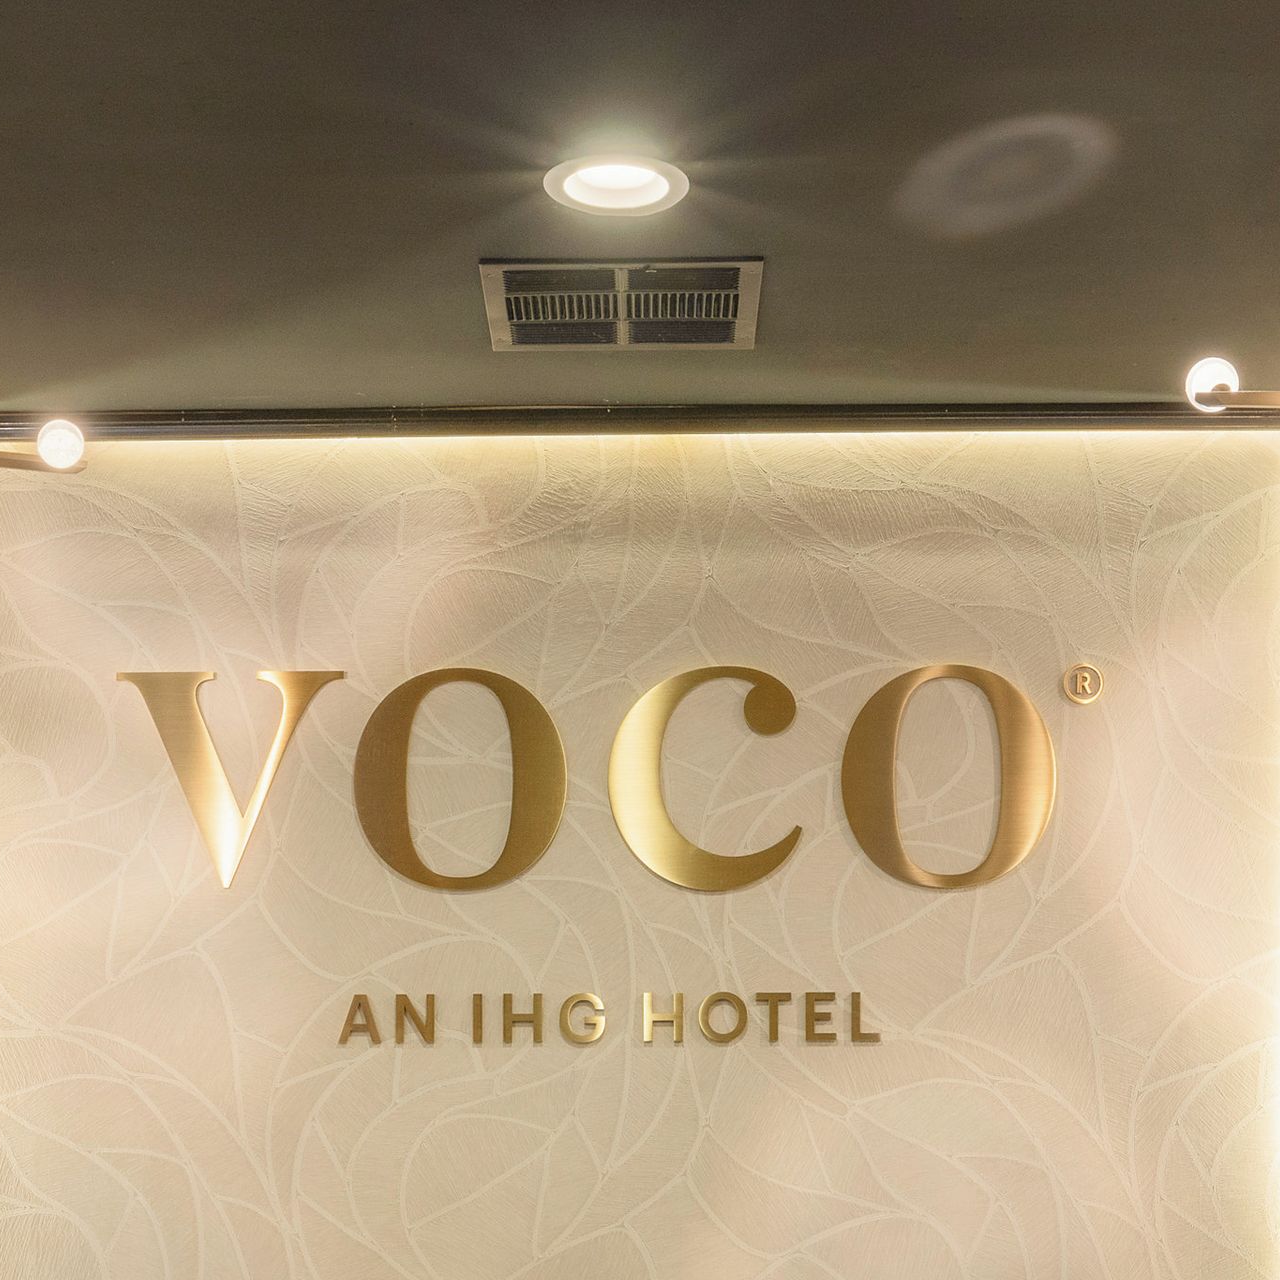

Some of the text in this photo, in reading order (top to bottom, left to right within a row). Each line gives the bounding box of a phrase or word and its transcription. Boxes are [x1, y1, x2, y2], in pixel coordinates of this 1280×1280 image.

[338, 990, 883, 1045] AN IHG HOTEL
